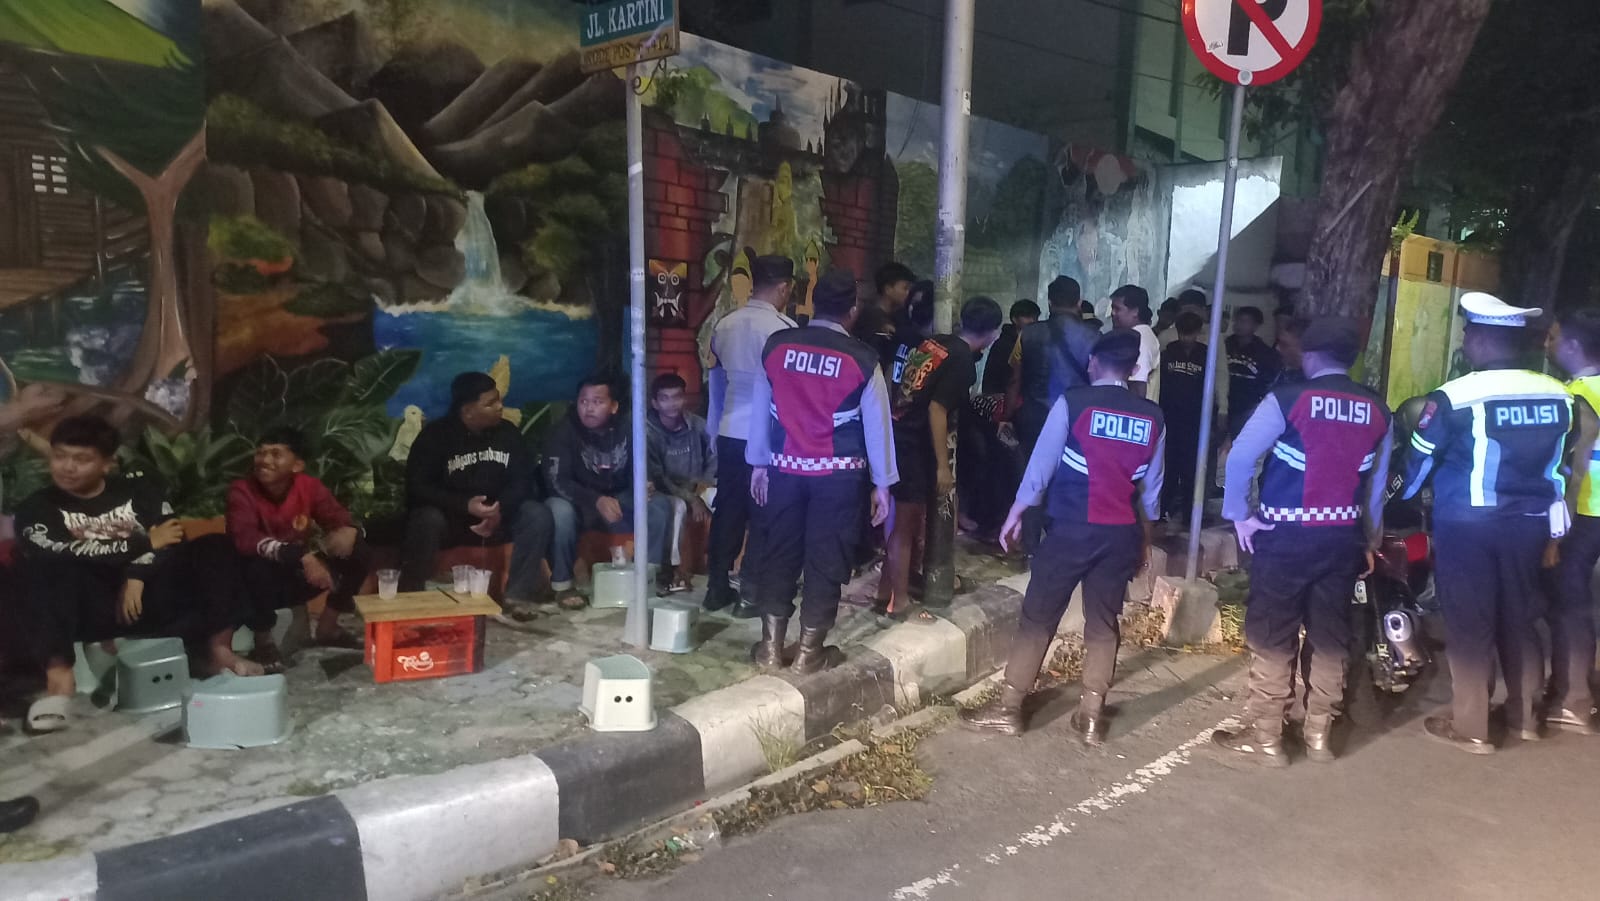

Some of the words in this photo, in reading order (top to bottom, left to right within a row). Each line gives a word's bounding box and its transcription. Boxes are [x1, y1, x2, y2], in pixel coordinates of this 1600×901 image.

[587, 13, 604, 39] JL.
[608, 0, 665, 33] KARTINI
[783, 349, 842, 379] POLISI
[1310, 396, 1371, 425] POLISI
[1496, 404, 1560, 427] POLISI
[1092, 412, 1150, 443] POLISI
